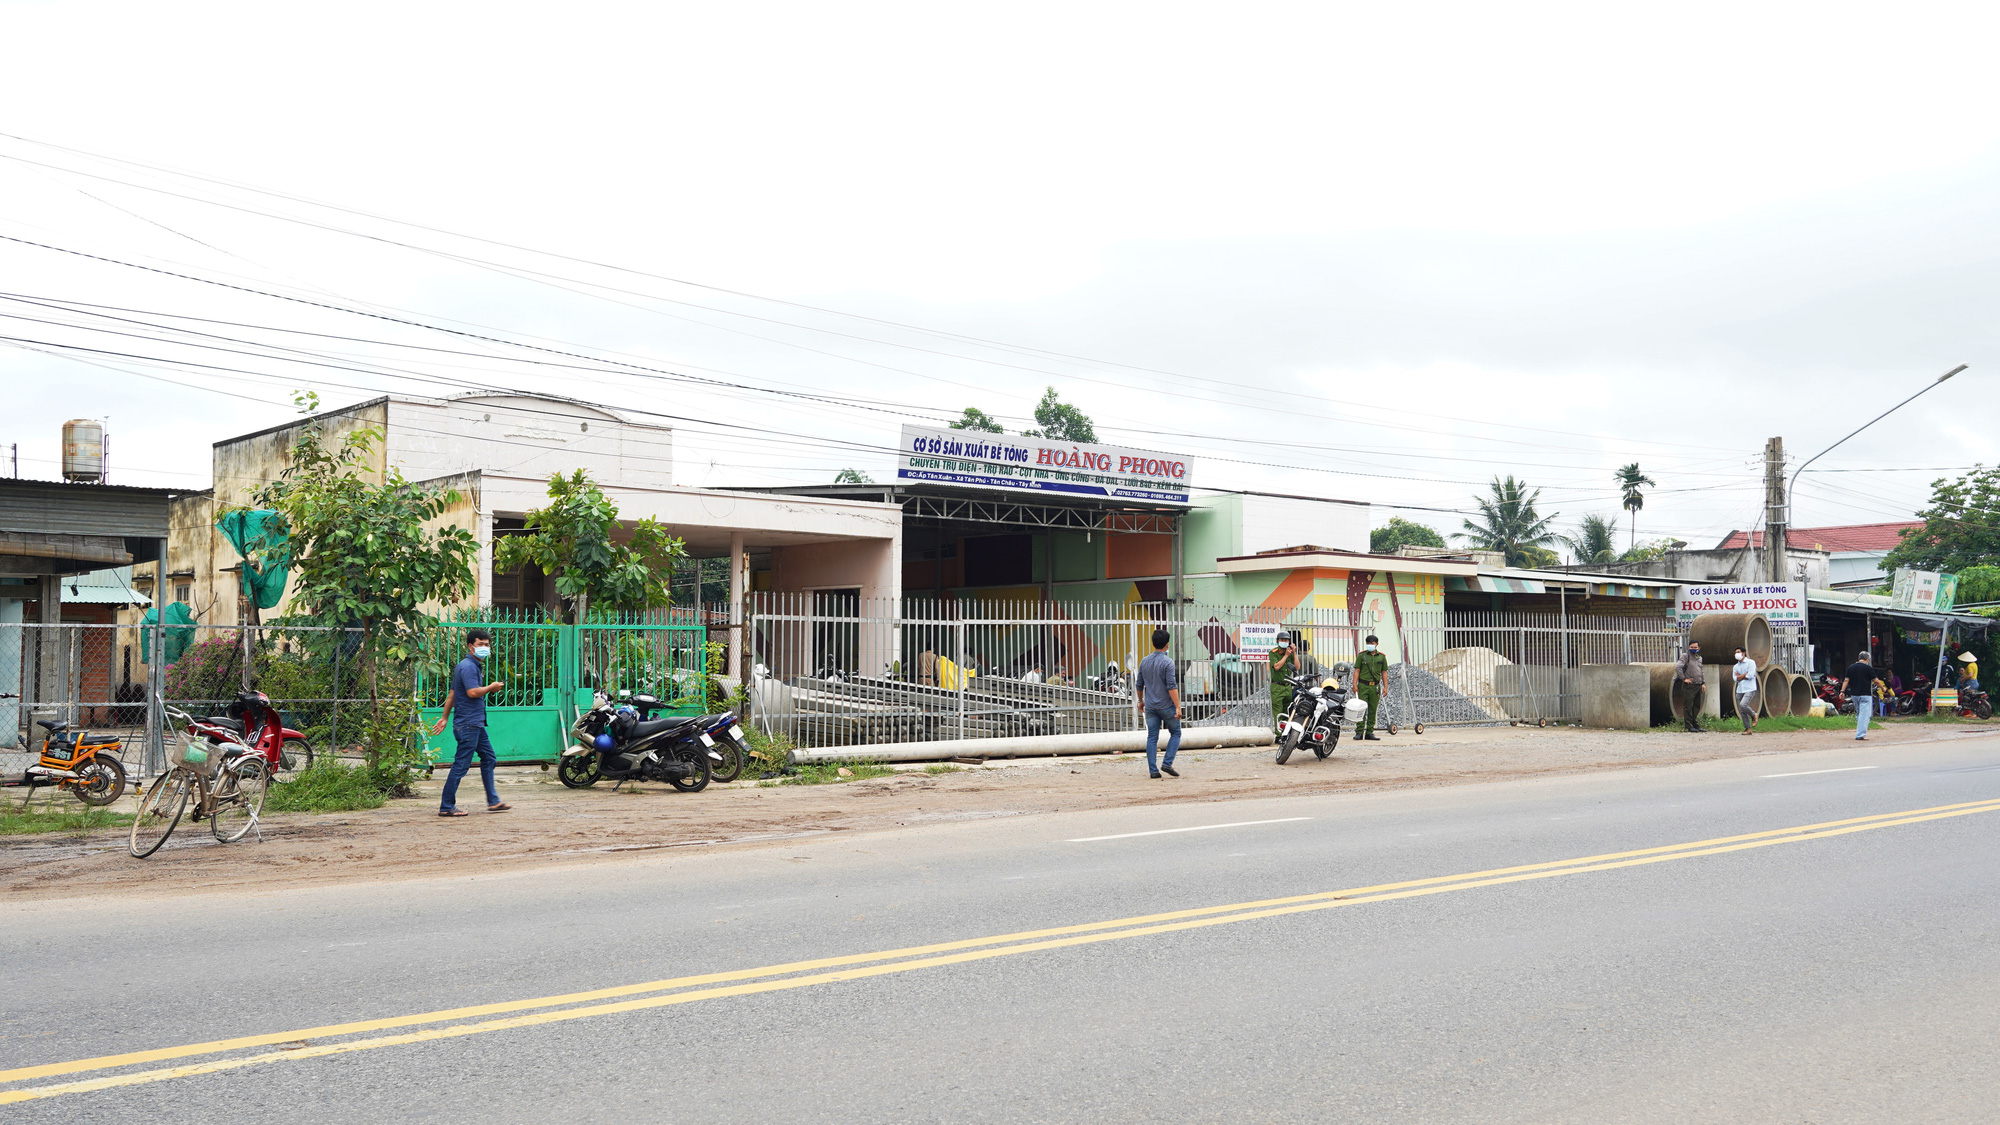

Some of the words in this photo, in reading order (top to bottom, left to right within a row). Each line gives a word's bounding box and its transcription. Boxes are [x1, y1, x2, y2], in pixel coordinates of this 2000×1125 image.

[913, 436, 927, 452] CƠ
[928, 435, 942, 454] SỞ
[943, 437, 962, 456] SẢN
[964, 440, 988, 459] XUẤT
[991, 443, 1001, 460] BÊ
[1004, 444, 1028, 462] TÔNG
[1036, 446, 1112, 471] HOÀNG
[1118, 455, 1186, 479] PHONG
[1690, 587, 1700, 596] CƠ
[1702, 585, 1712, 595] SỞ
[1713, 585, 1729, 595] SẢN
[1731, 585, 1751, 594] XUẤT
[1753, 585, 1764, 594] BÊ
[1765, 585, 1787, 593] TÔNG
[1681, 598, 1735, 611] HOÀNG
[1742, 598, 1797, 610] PHONG
